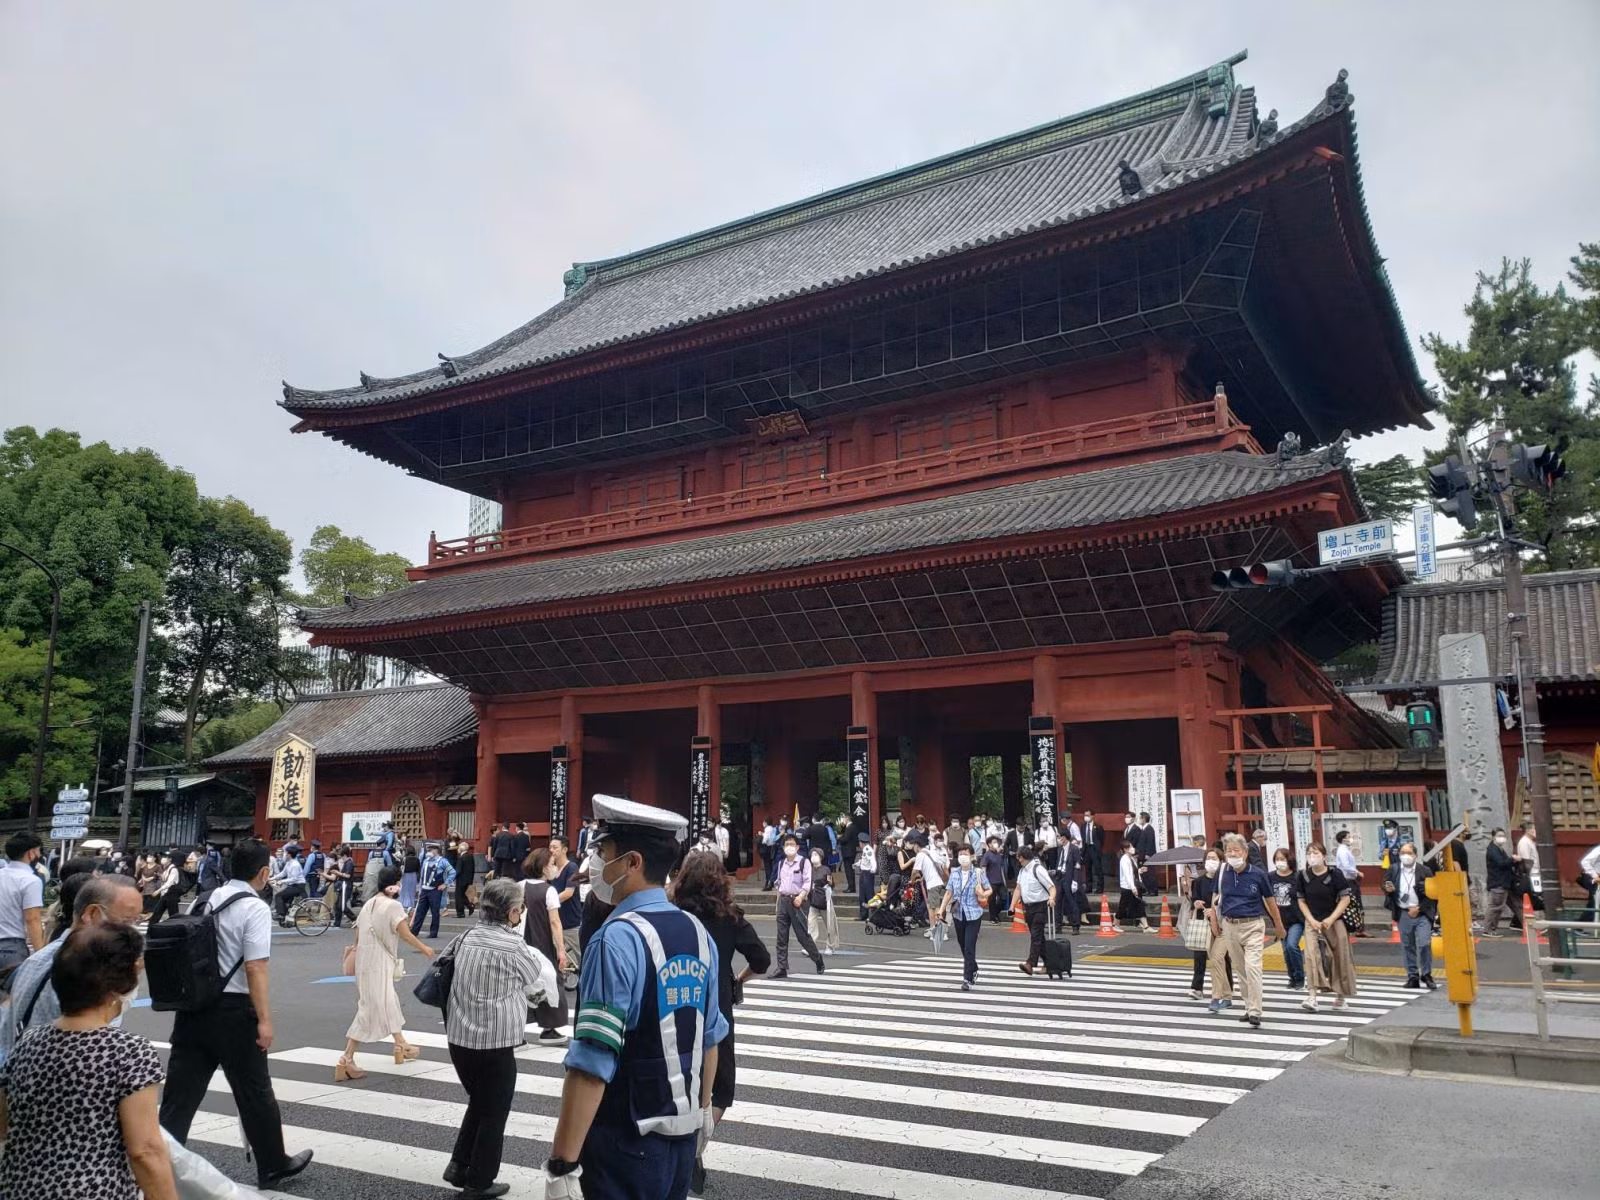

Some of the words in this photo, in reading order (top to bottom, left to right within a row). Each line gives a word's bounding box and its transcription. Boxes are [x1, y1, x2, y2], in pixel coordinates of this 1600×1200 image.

[1325, 525, 1386, 549] 増上寺前
[1331, 548, 1352, 558] Zojoji
[1354, 542, 1381, 553] Temple
[278, 745, 304, 815] 勧進
[853, 759, 866, 816] 盂蘭盆会
[660, 959, 707, 986] POLICE
[666, 986, 701, 1005] 警視庁
